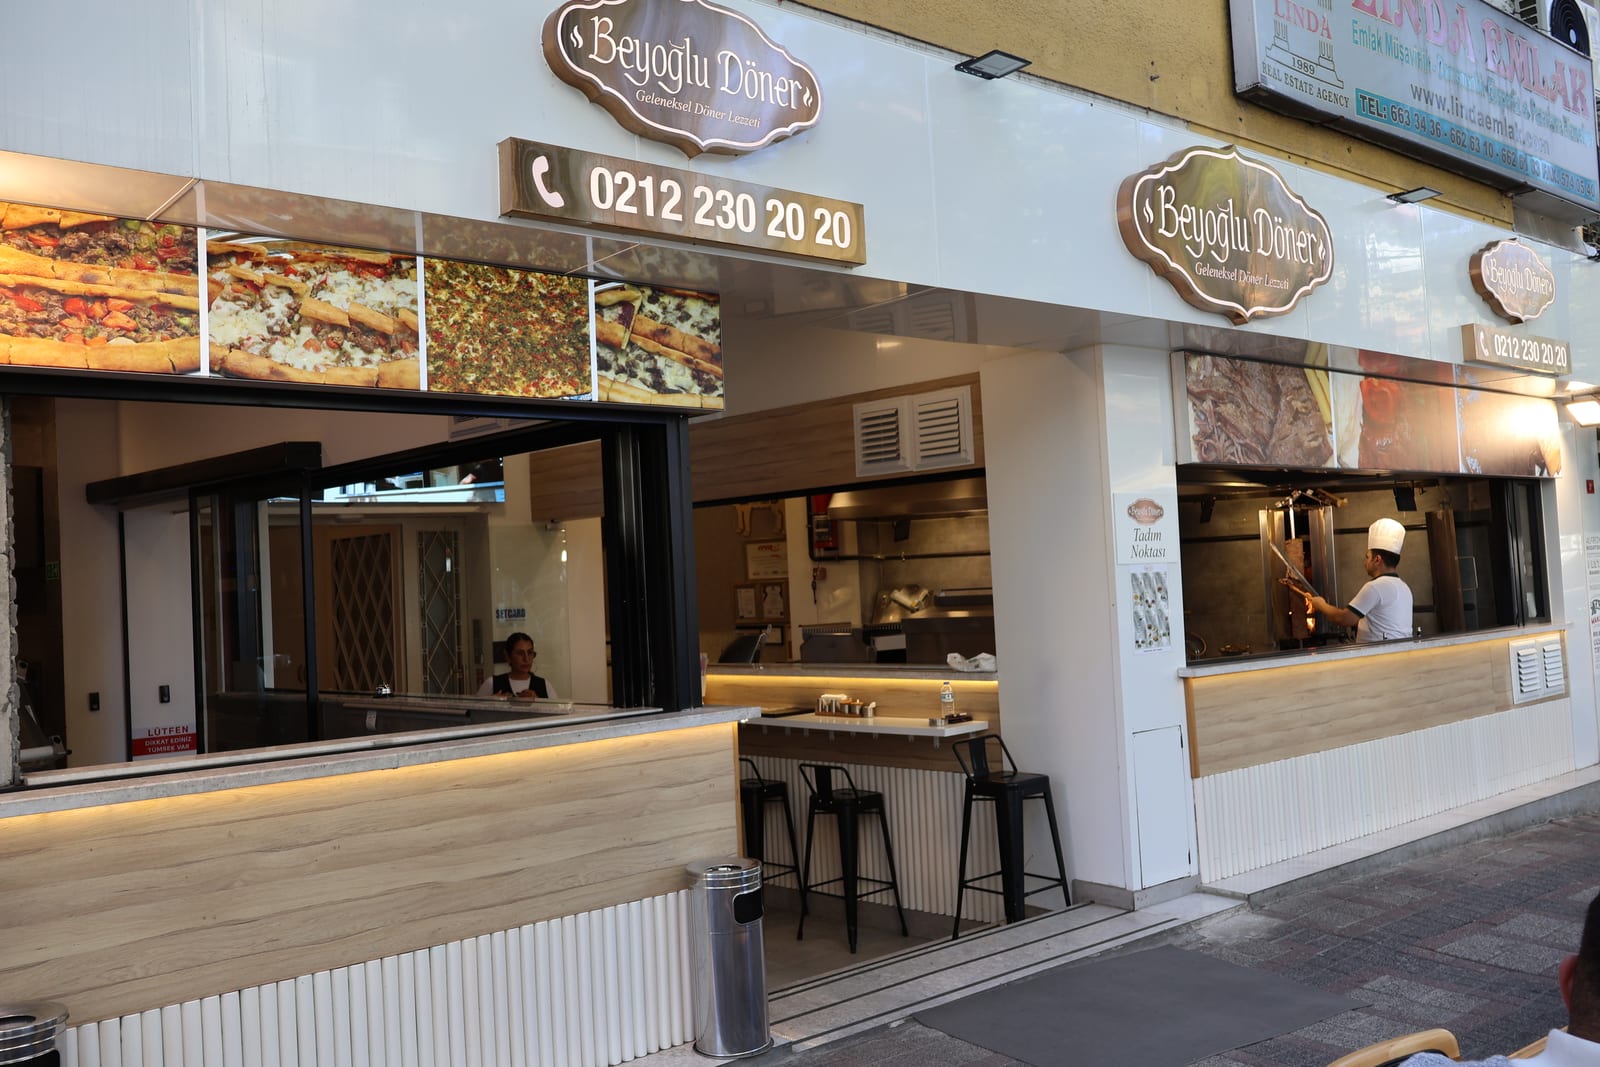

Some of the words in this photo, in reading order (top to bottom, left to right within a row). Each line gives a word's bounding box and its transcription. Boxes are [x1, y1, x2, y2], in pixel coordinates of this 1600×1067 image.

[1274, 0, 1332, 39] LINDA
[1352, 19, 1382, 54] Emlak
[588, 16, 710, 94] Beyoğlu
[717, 50, 802, 110] Döner
[1292, 57, 1315, 75] 1989
[1262, 62, 1282, 81] REAL
[1284, 73, 1314, 95] ESTATE
[1316, 88, 1350, 108] AGENCY
[635, 89, 692, 113] Geleneksel
[694, 103, 725, 120] Döner
[728, 110, 761, 128] Lezzeti
[1360, 94, 1387, 119] TEL:
[1390, 105, 1411, 126] 663
[1415, 113, 1426, 132] 34
[1430, 119, 1441, 138] 36
[1451, 128, 1466, 148] 662
[1470, 135, 1481, 153] 63
[1483, 140, 1494, 158] 10
[590, 166, 683, 222] 0212
[694, 185, 756, 234] 230
[766, 199, 804, 241] 20
[814, 208, 851, 249] 20
[1158, 185, 1250, 263] Beyoğlu
[1253, 208, 1318, 264] Döner
[1195, 262, 1237, 281] Geleneksel
[1239, 270, 1262, 286] Döner
[1264, 274, 1289, 290] Lezzeti
[1524, 267, 1550, 295] Döner
[1494, 334, 1520, 359] 0212
[1521, 339, 1539, 362] 230
[1541, 344, 1553, 365] 20
[1556, 346, 1567, 367] 20
[1130, 544, 1166, 559] Noktası
[1133, 527, 1162, 542] Tadım
[496, 608, 525, 618] SETCARD
[147, 725, 189, 737] LÜTFEN
